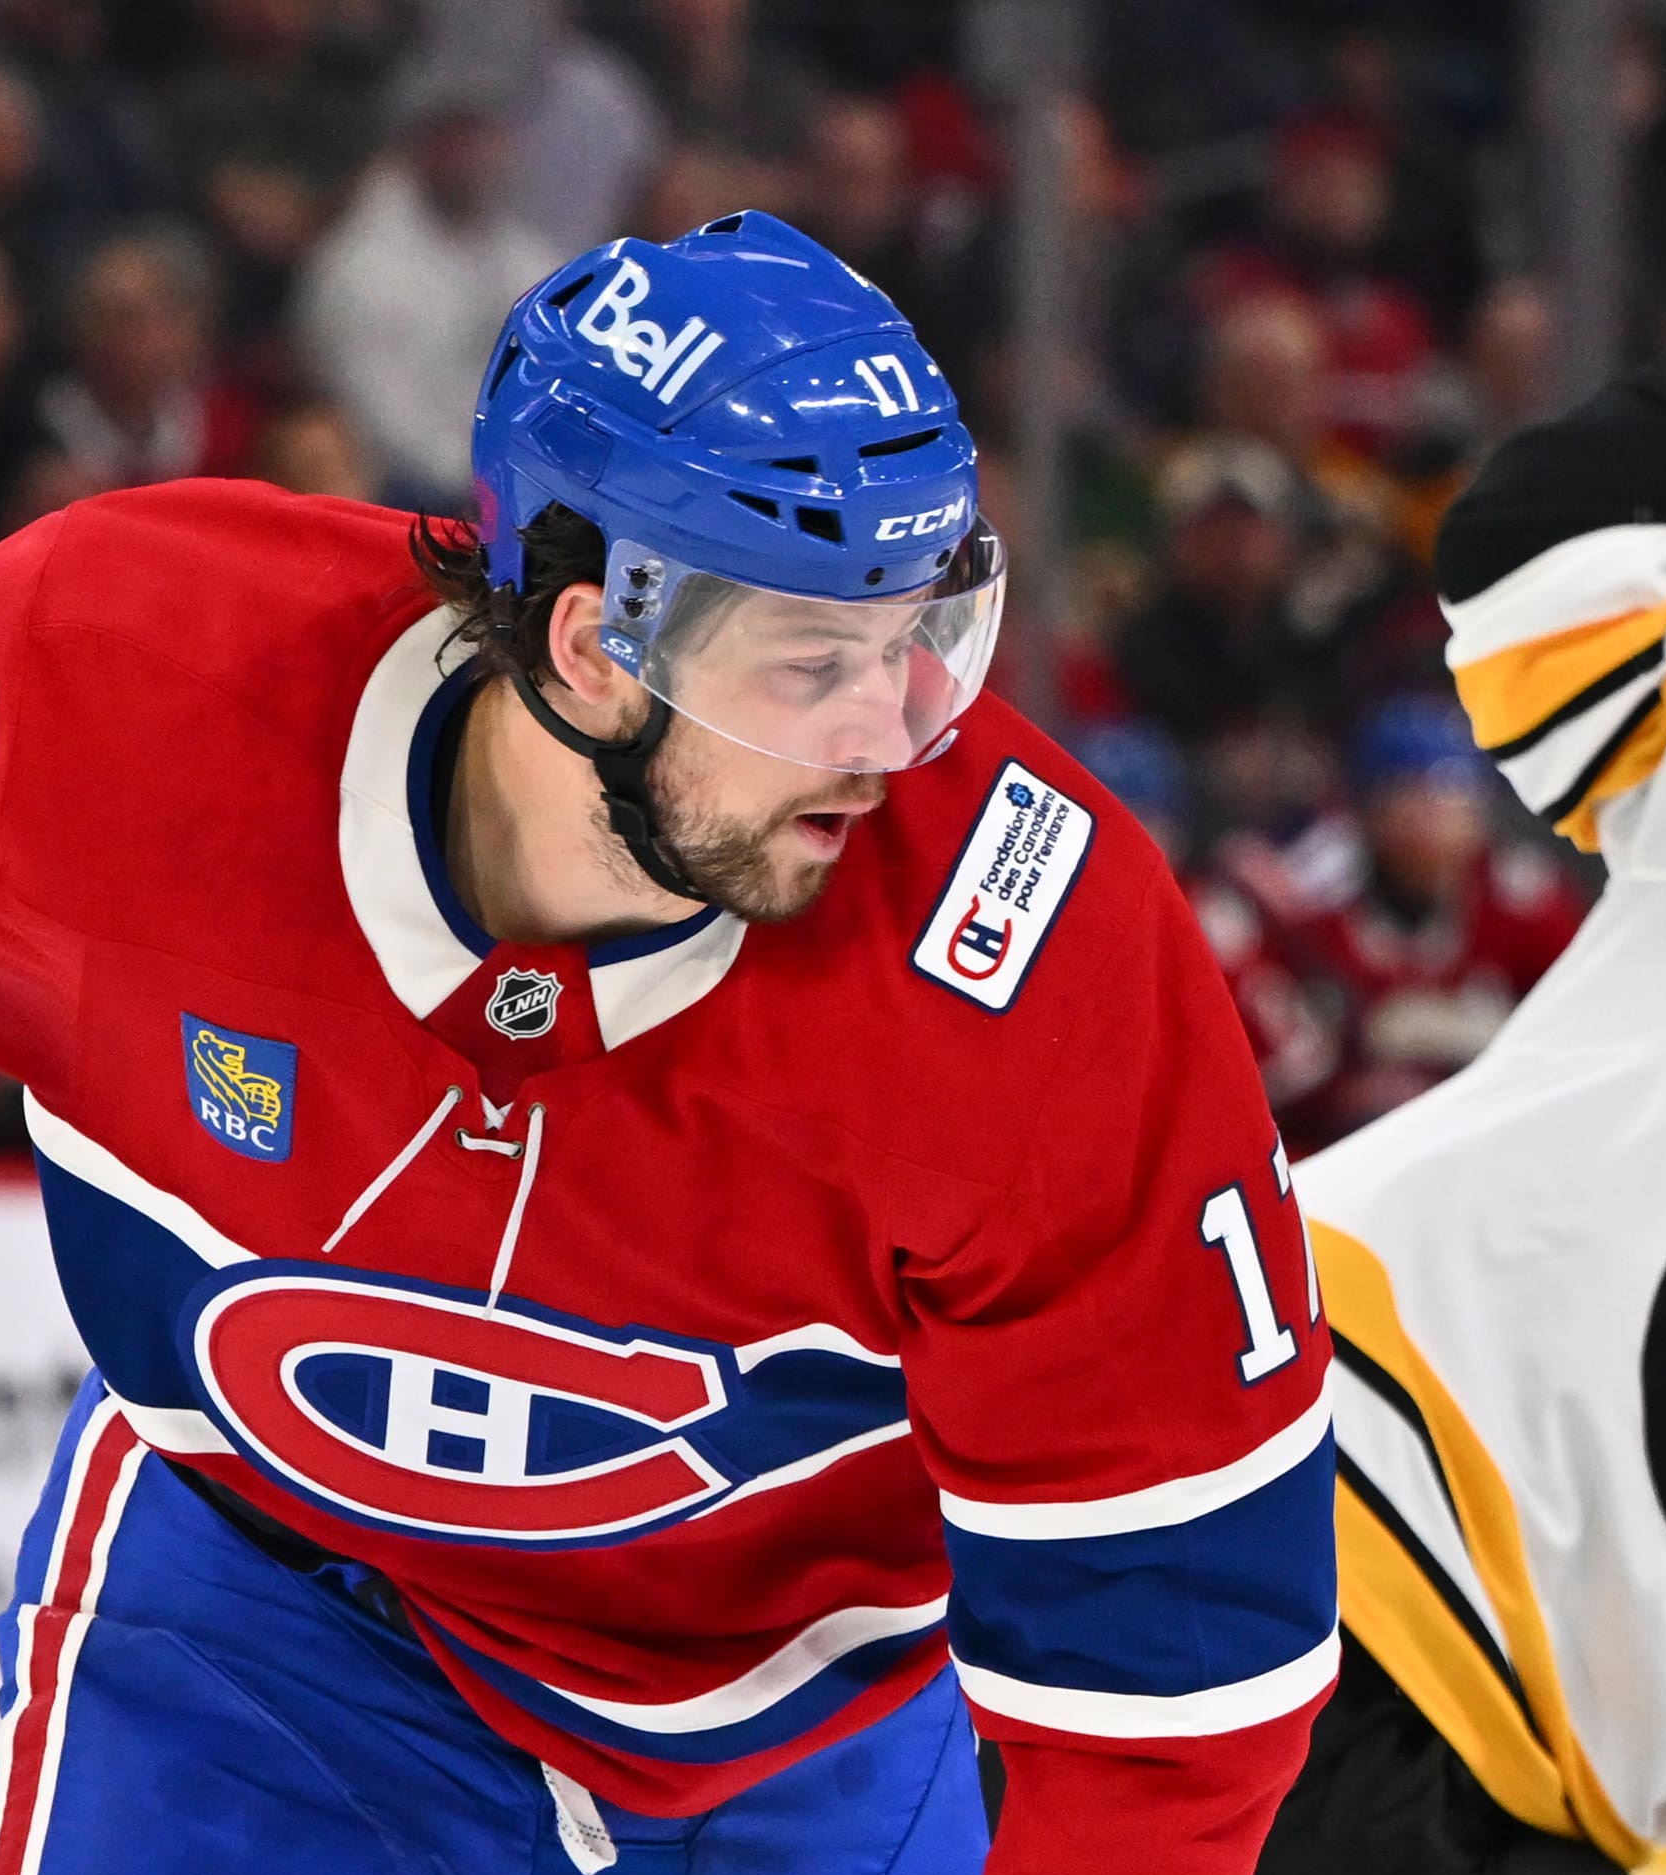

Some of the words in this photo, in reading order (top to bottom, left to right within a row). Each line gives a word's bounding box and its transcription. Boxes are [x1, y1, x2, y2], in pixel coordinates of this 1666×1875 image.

[576, 257, 727, 406] Bell
[854, 354, 921, 418] 17
[874, 495, 968, 542] CCM
[979, 808, 1029, 894] Fondation
[998, 868, 1022, 902] des
[1013, 789, 1057, 865] Canadiens
[1014, 867, 1043, 913] pour
[500, 988, 550, 1021] LNH
[199, 1095, 276, 1153] RBC
